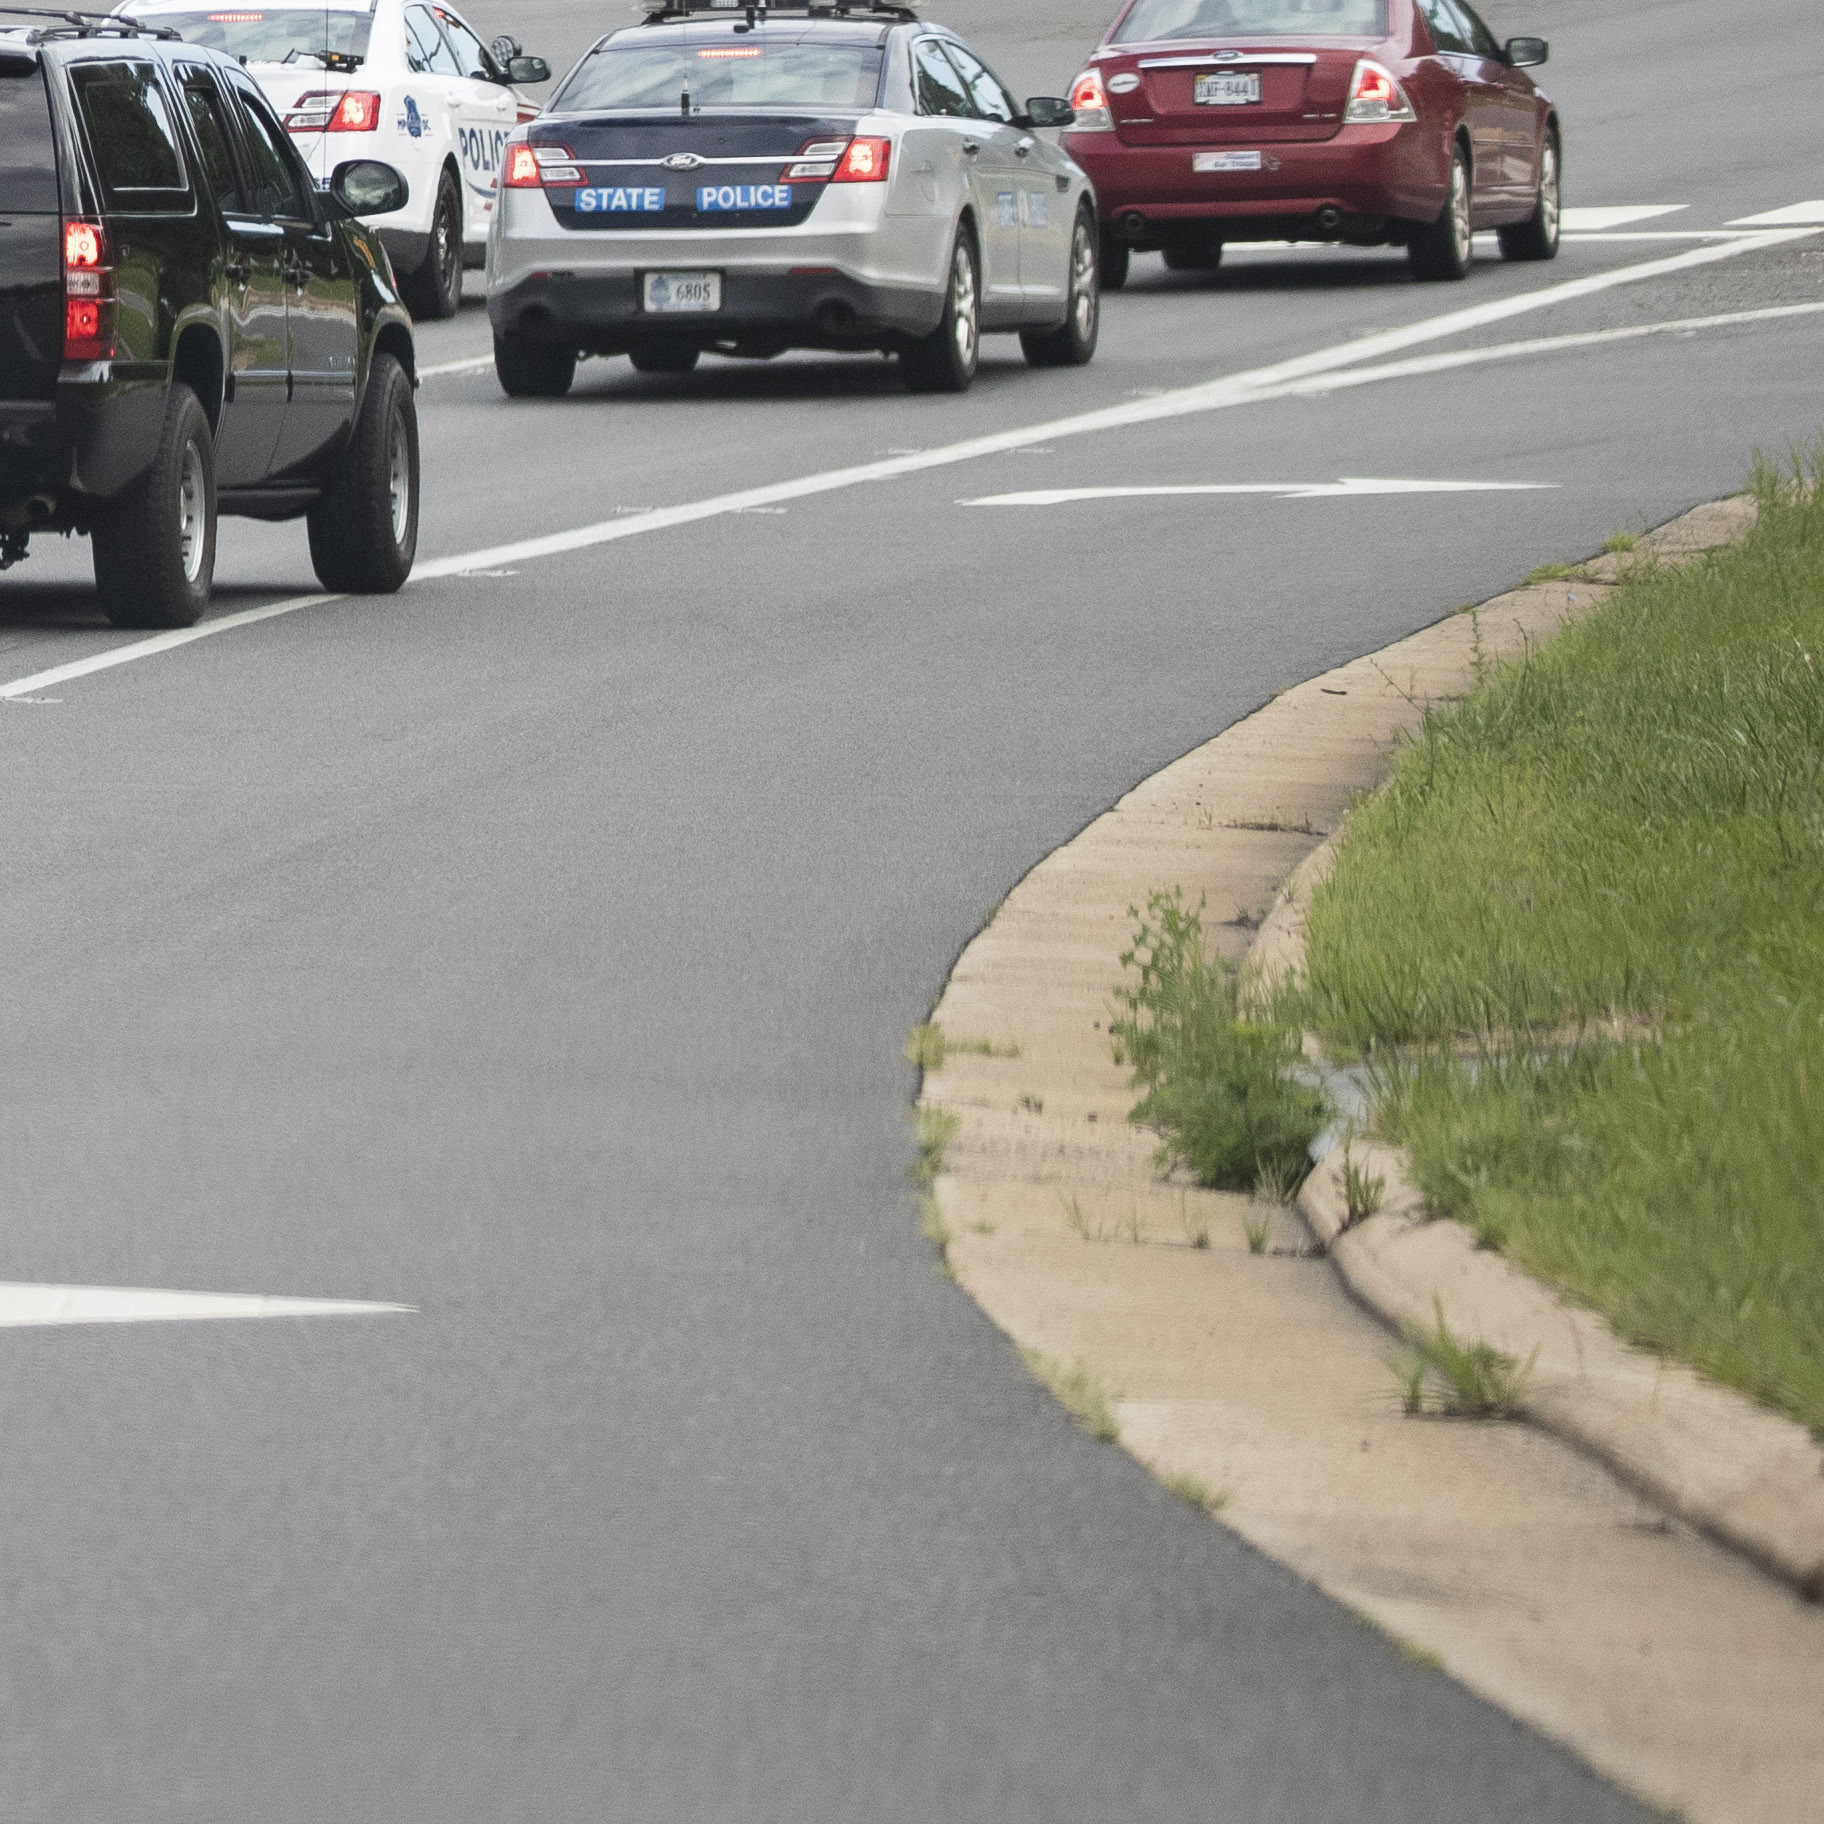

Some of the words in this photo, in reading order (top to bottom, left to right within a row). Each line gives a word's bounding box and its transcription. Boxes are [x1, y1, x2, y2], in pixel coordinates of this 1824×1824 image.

[580, 188, 661, 212] STATE
[702, 184, 789, 210] POLICE
[676, 282, 711, 302] 6805
